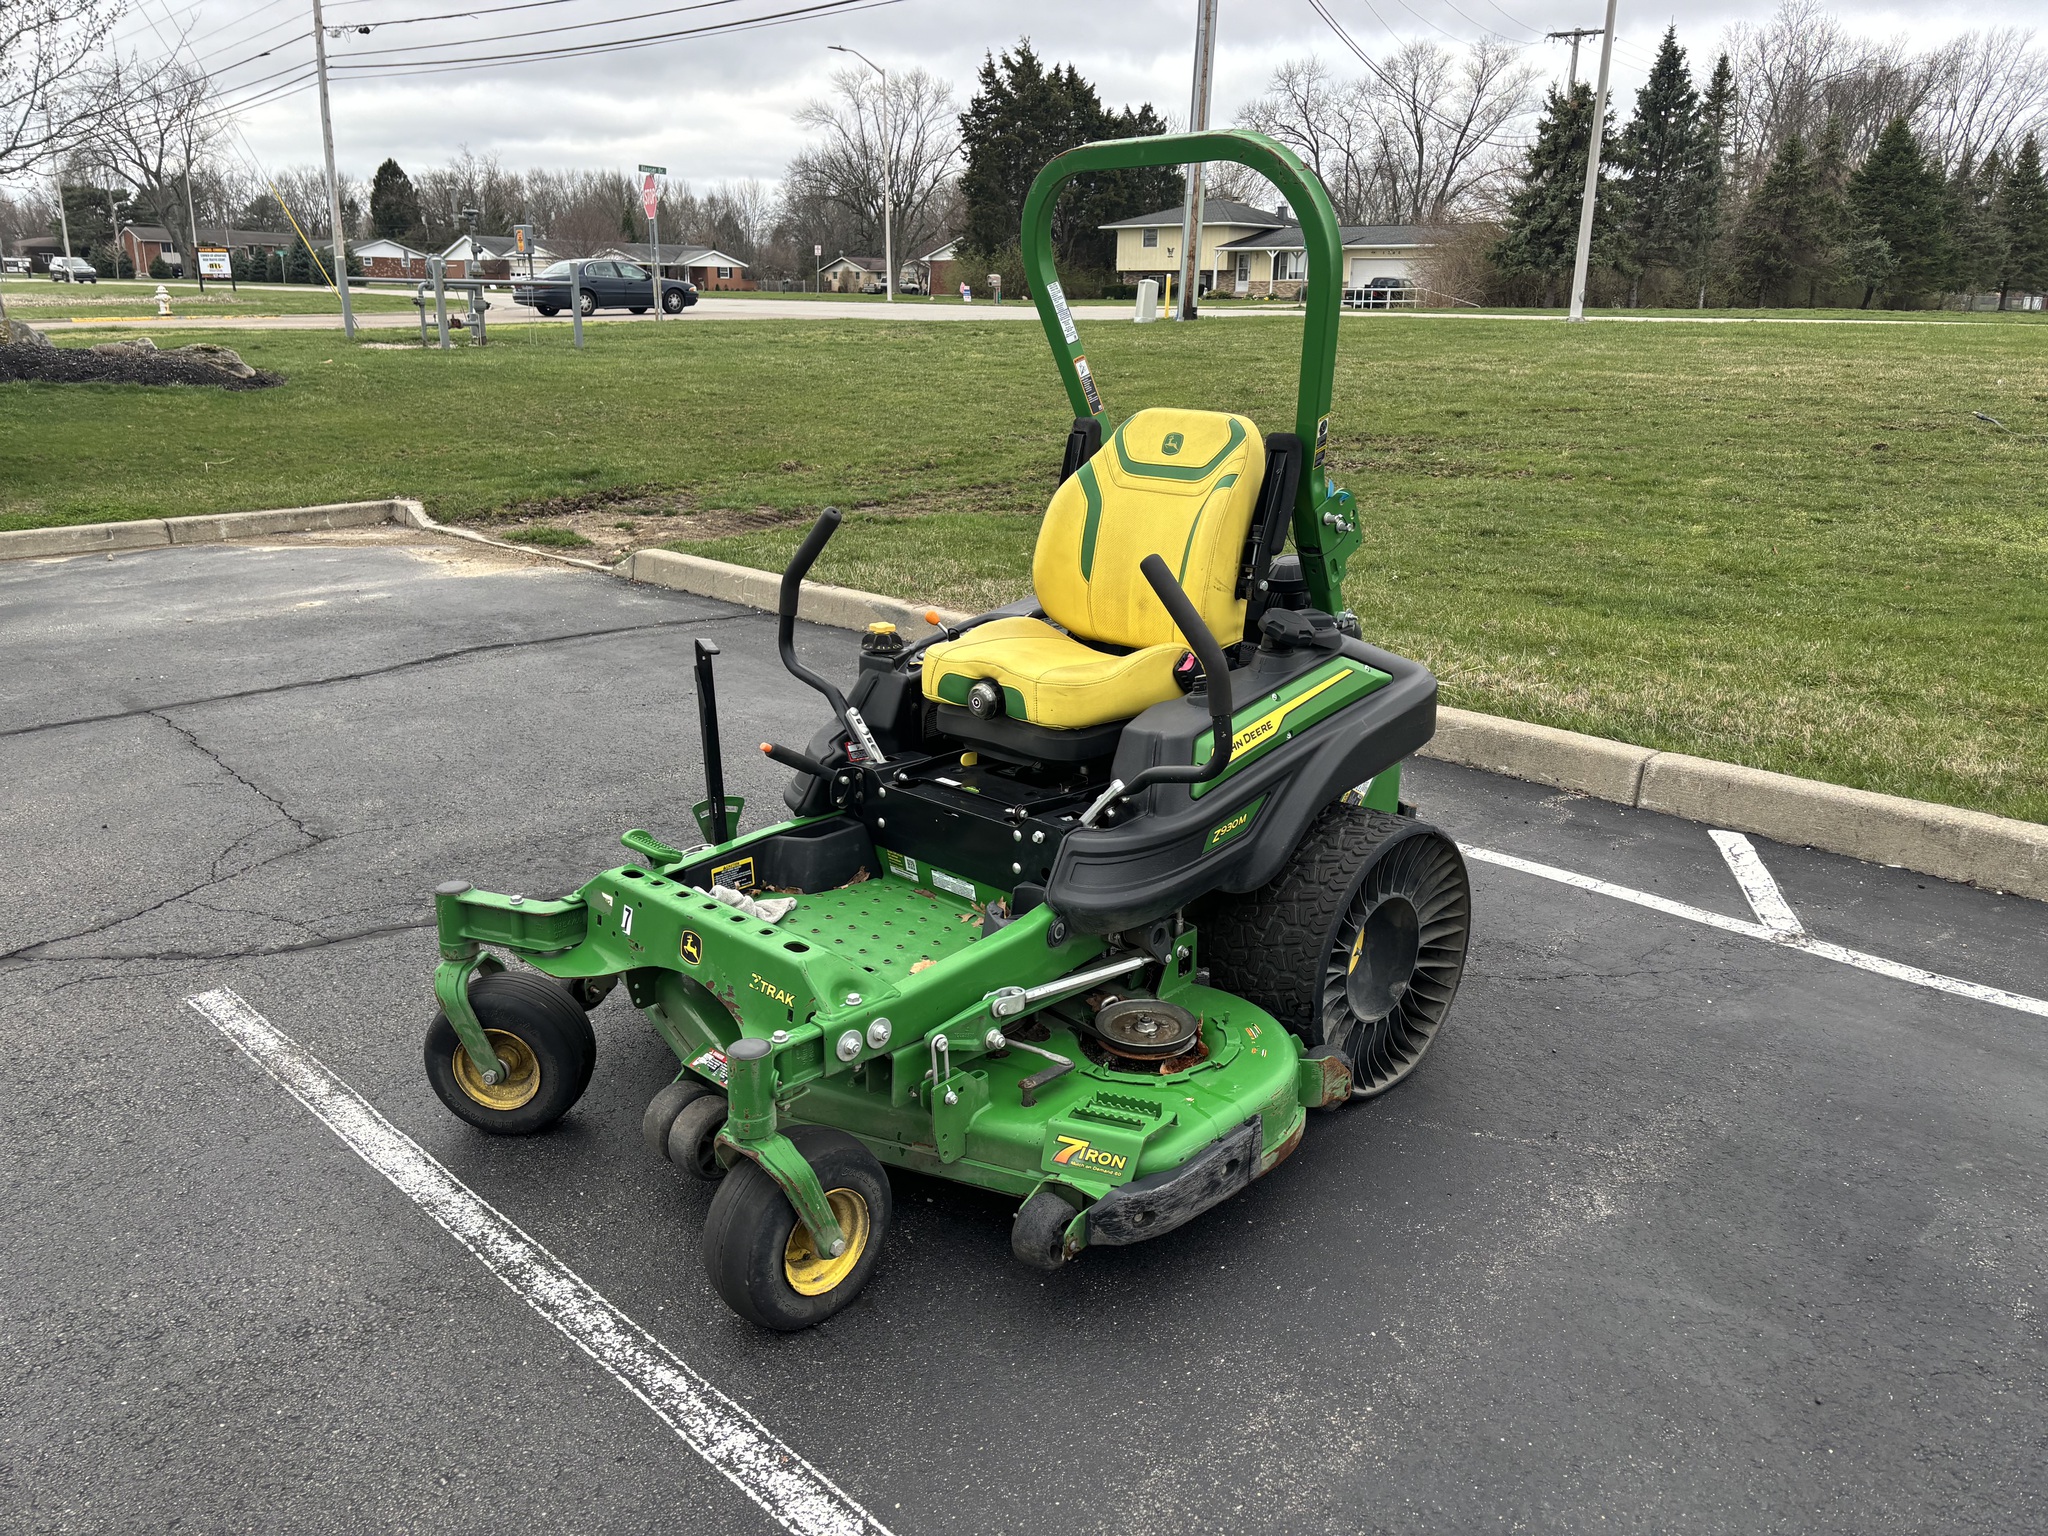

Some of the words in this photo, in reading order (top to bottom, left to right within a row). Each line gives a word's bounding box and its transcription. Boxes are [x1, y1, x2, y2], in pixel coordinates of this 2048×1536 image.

[644, 188, 655, 205] STOP
[1243, 720, 1273, 744] DEERE
[1212, 813, 1247, 843] Z930M
[1078, 1146, 1127, 1170] IRON
